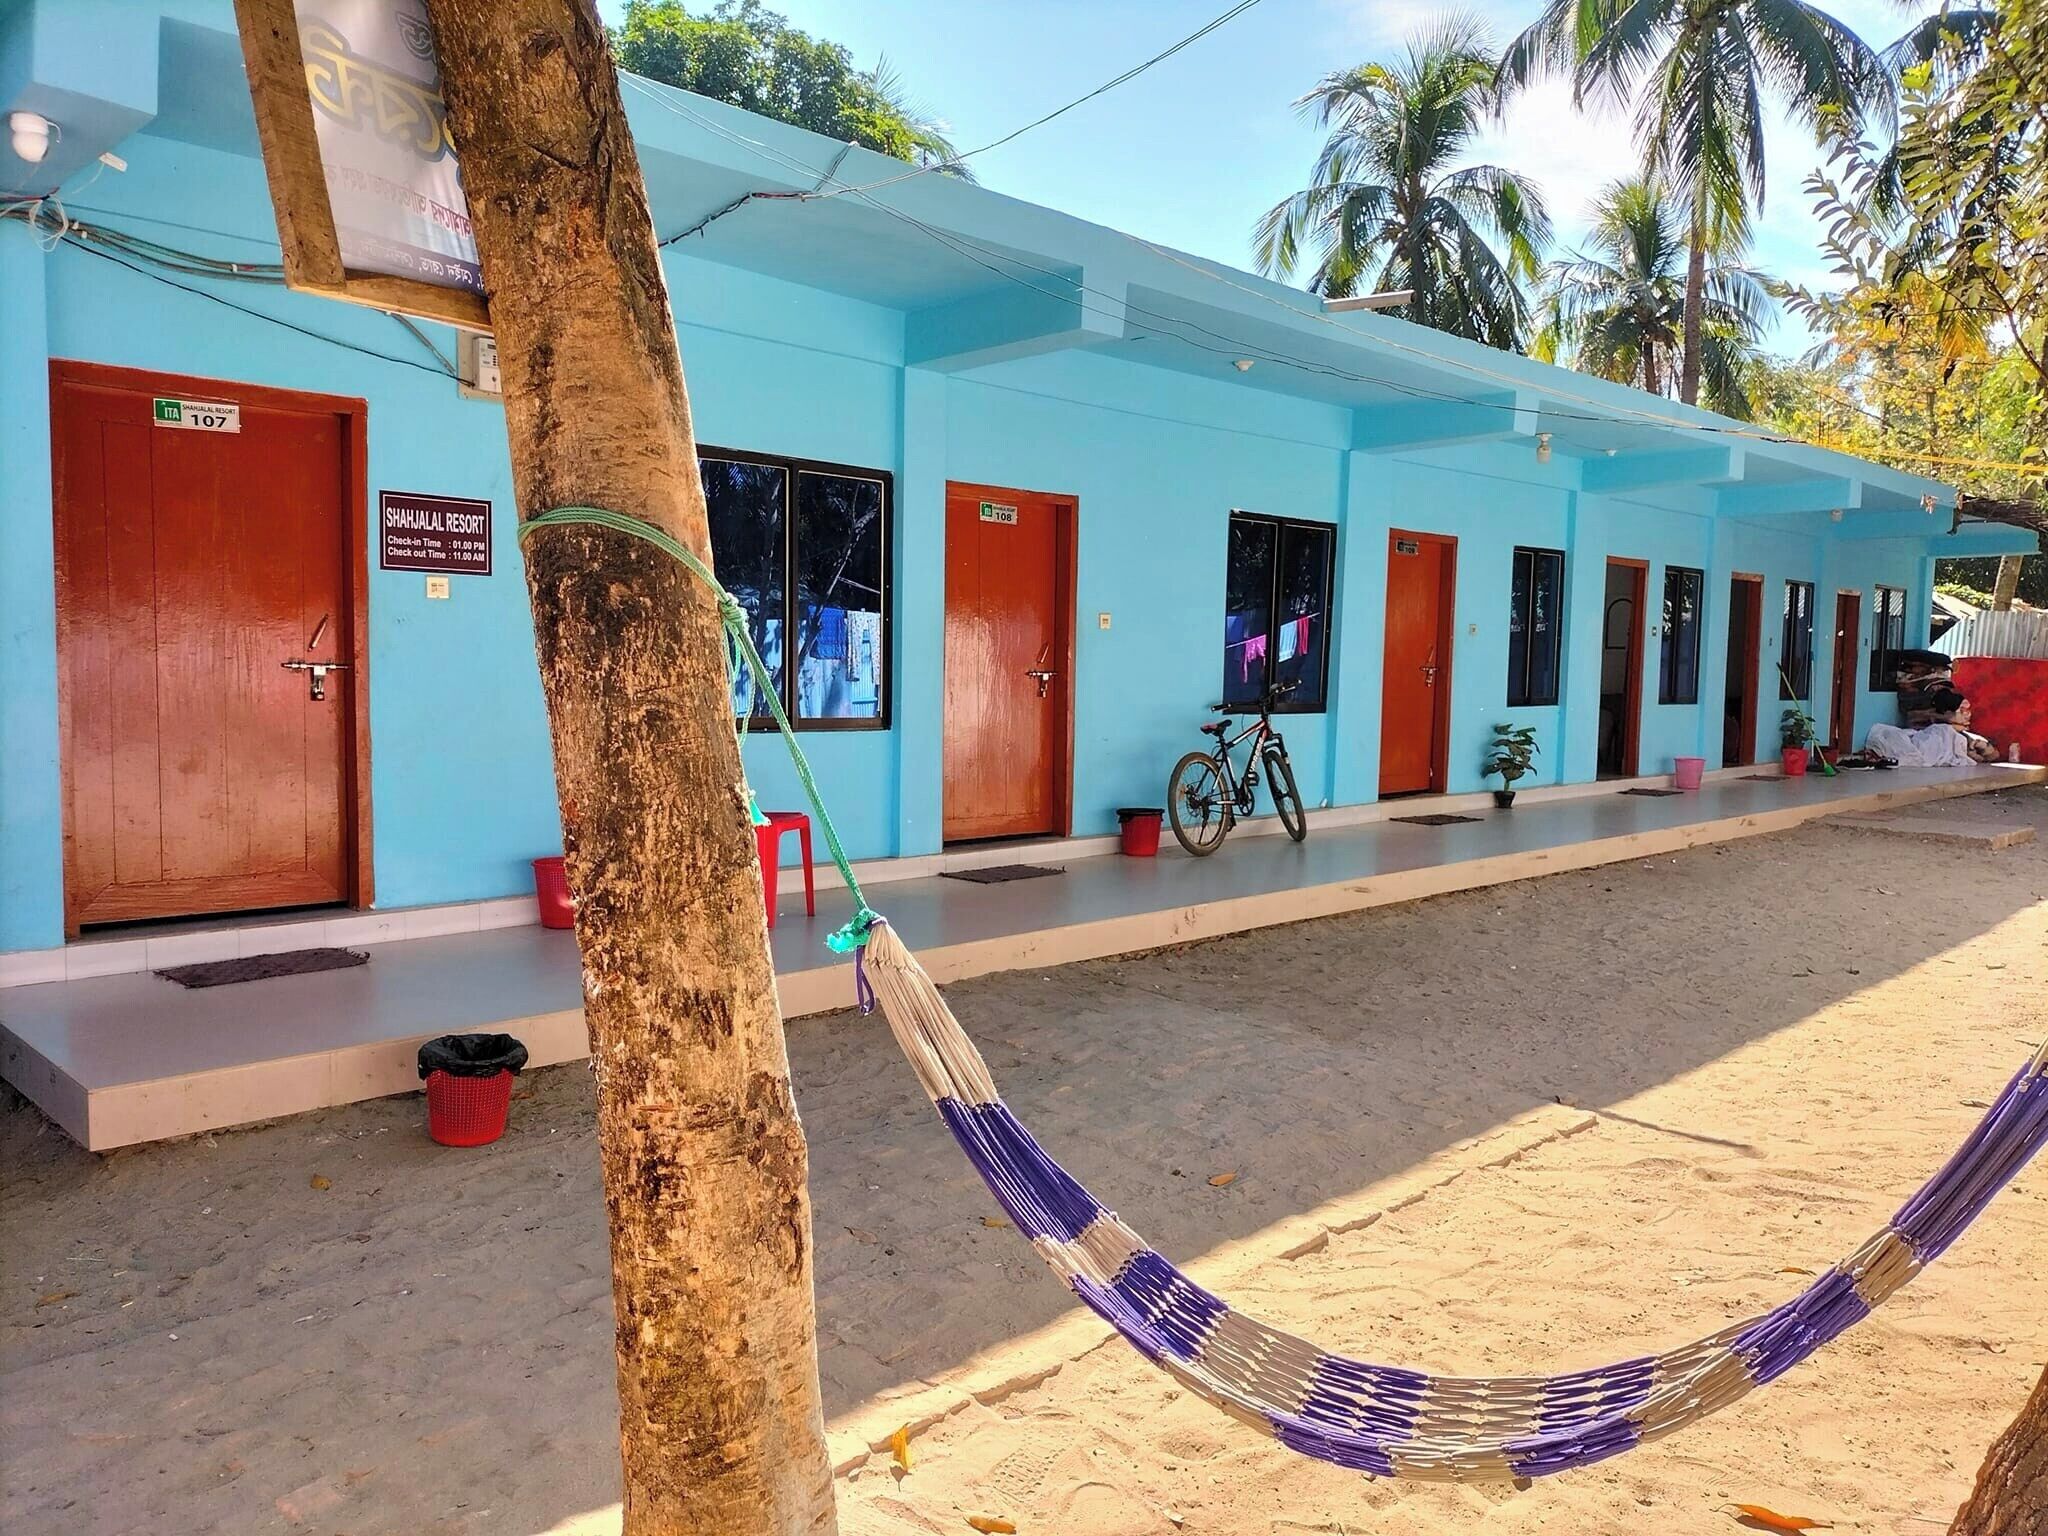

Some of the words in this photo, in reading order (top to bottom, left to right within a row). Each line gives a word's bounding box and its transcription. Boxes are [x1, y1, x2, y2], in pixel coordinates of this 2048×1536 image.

[164, 407, 180, 419] ITA
[215, 407, 236, 415] RESORT
[191, 414, 227, 428] 107
[386, 507, 445, 532] SHAHJALAL
[446, 512, 485, 534] RESORT
[996, 512, 1012, 521] 108
[387, 535, 421, 546] Check-in
[423, 538, 441, 548] Time
[452, 540, 473, 550] 01.00
[473, 542, 485, 551] PM
[387, 547, 412, 557] Check
[413, 550, 426, 558] out
[428, 550, 446, 559] Time
[453, 551, 472, 561] 11.00
[473, 553, 485, 562] AM
